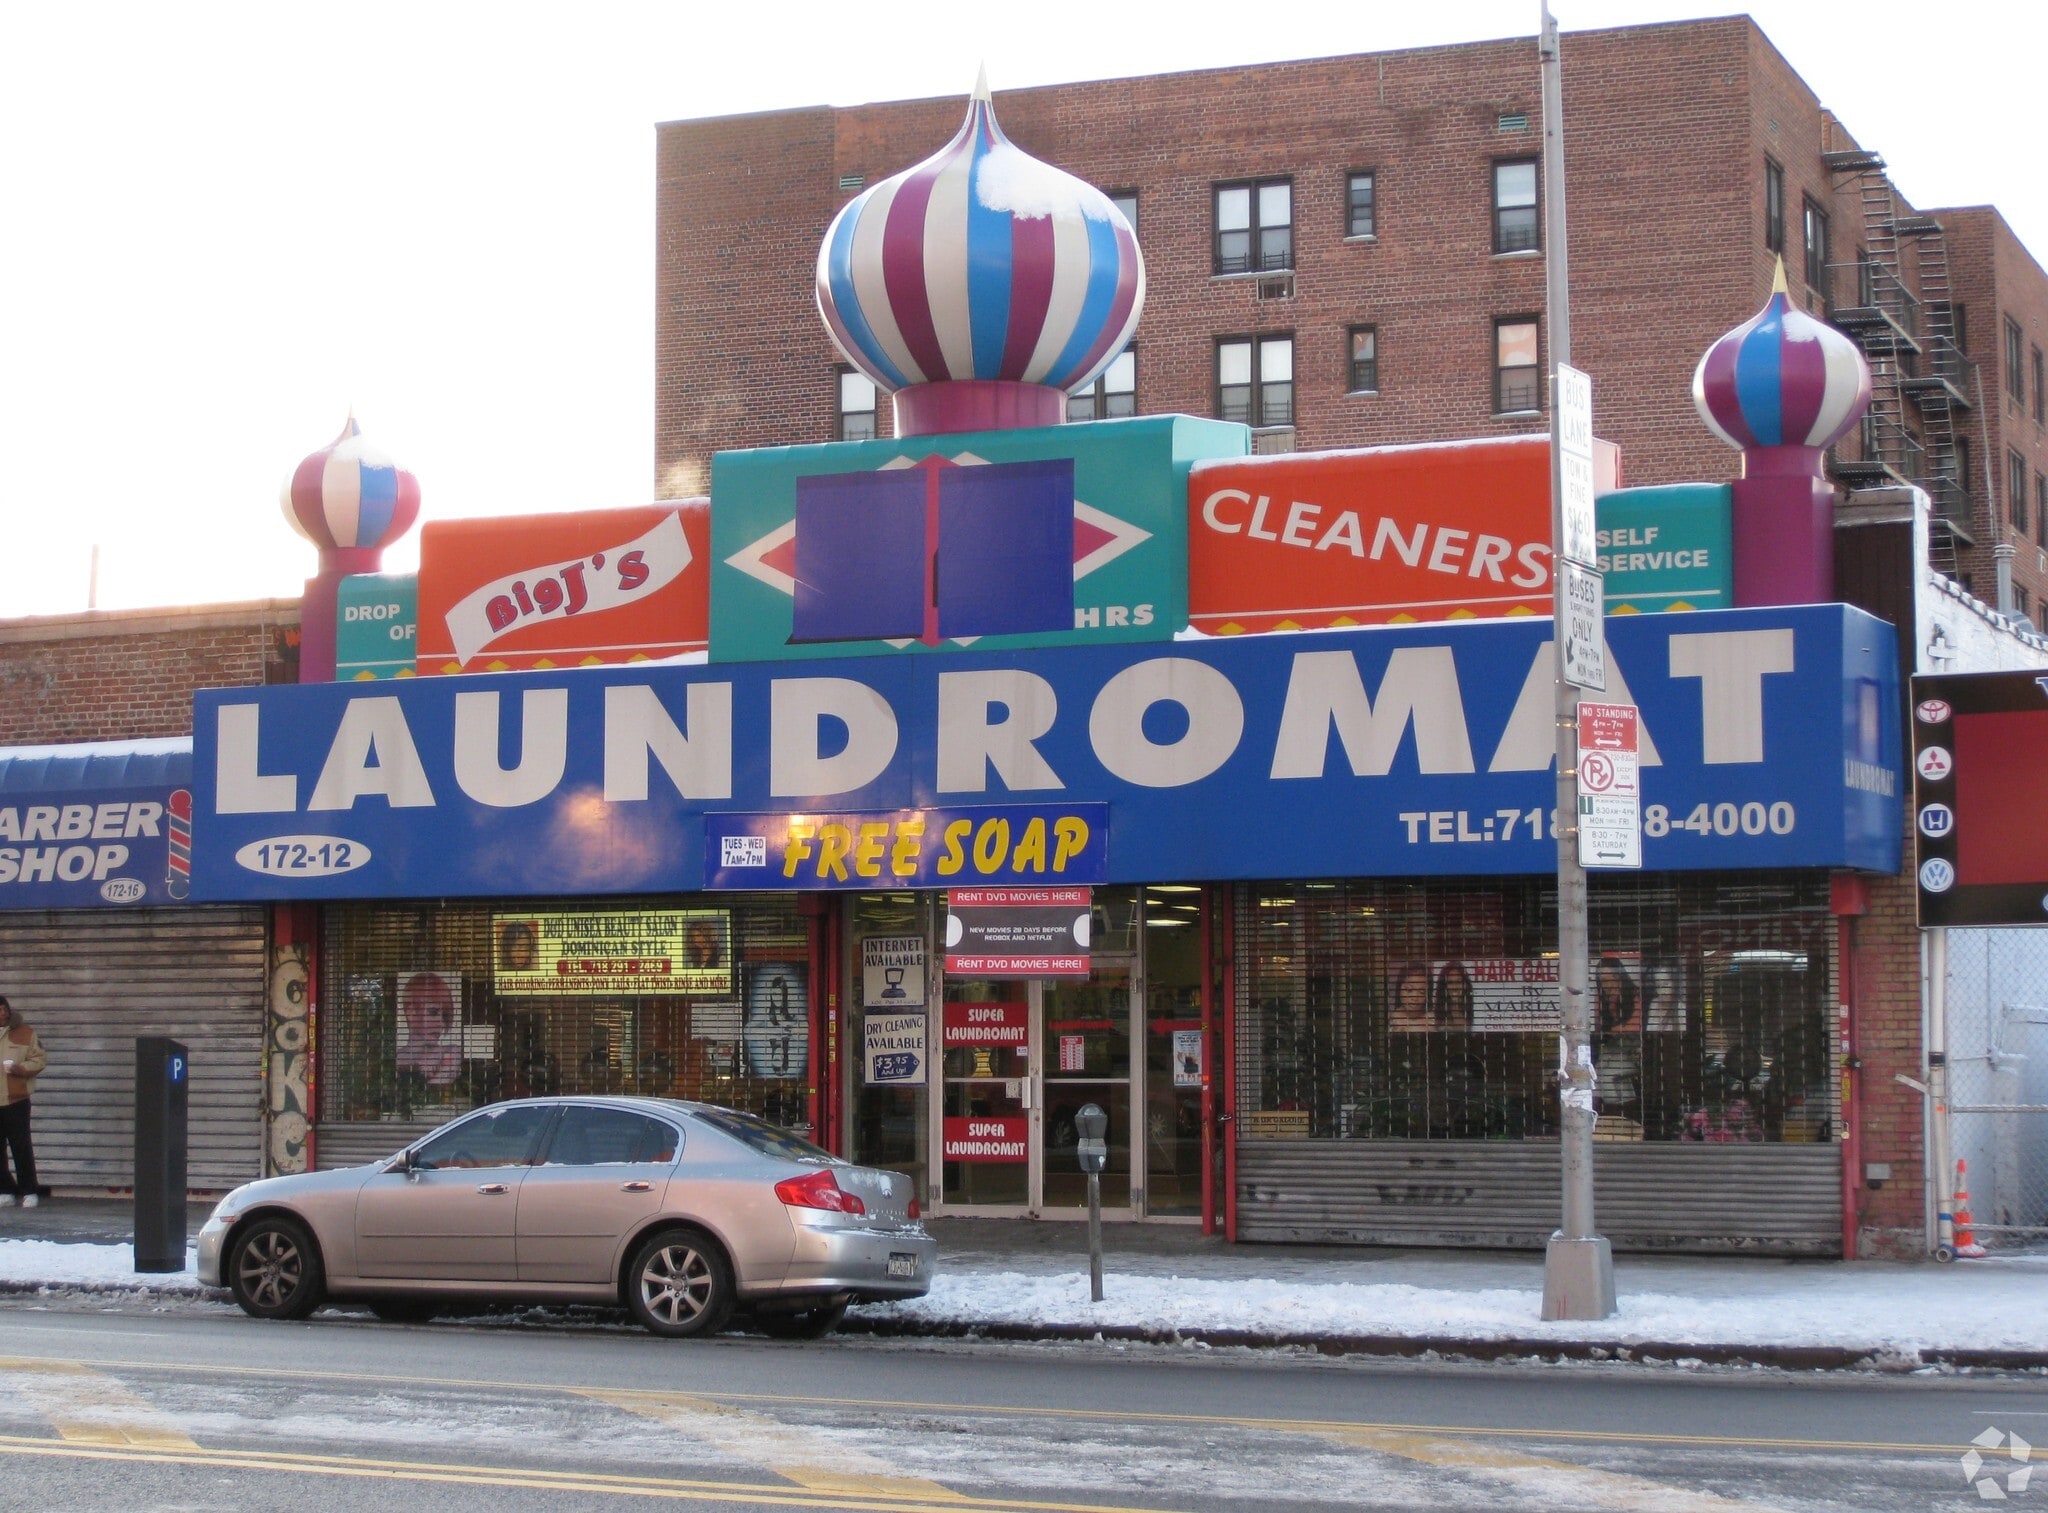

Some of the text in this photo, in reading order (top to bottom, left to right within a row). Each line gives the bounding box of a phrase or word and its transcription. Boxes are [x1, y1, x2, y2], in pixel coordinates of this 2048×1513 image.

[1566, 380, 1585, 411] BUS
[1563, 414, 1588, 448] LANE
[1566, 458, 1580, 478] TOW
[1570, 482, 1586, 504] FINE
[1202, 488, 1553, 588] CLEANERS
[1596, 527, 1658, 549] SELF
[1596, 549, 1709, 572] SERVICE
[1569, 575, 1595, 604] BUSES
[344, 604, 401, 622] DROP
[1074, 604, 1155, 628] HRS
[1572, 617, 1593, 643] ONLY
[215, 628, 1796, 814] LAUNDROMAT
[1582, 707, 1634, 719] NO STANDING
[724, 839, 743, 849] TUES
[748, 838, 764, 849] WED
[782, 816, 1091, 882] FREE SOAP
[1593, 840, 1628, 848] SATURDAY
[0, 844, 130, 884] SHOP
[257, 843, 352, 869] 172-12
[725, 850, 763, 865] 7AM-7PM
[106, 883, 140, 897] 172-16
[957, 891, 1081, 901] RENT DVD MOVIES HERE!
[561, 940, 667, 955] DOMINICAN STYLE
[866, 939, 920, 952] INTERNET
[864, 954, 923, 967] AVAILABLE
[957, 960, 1082, 969] RENT DVD MOVIES HERE!
[1473, 960, 1516, 982] HAIR
[968, 1008, 1005, 1022] SUPER
[866, 1017, 923, 1035] DRY CLEANING
[946, 1027, 1025, 1041] LAUNDROMAT
[866, 1037, 923, 1049] AVAILABLE
[876, 1055, 909, 1069] $3.95
[968, 1123, 1005, 1137] SUPER
[946, 1141, 1025, 1156] LAUNDROMAT
